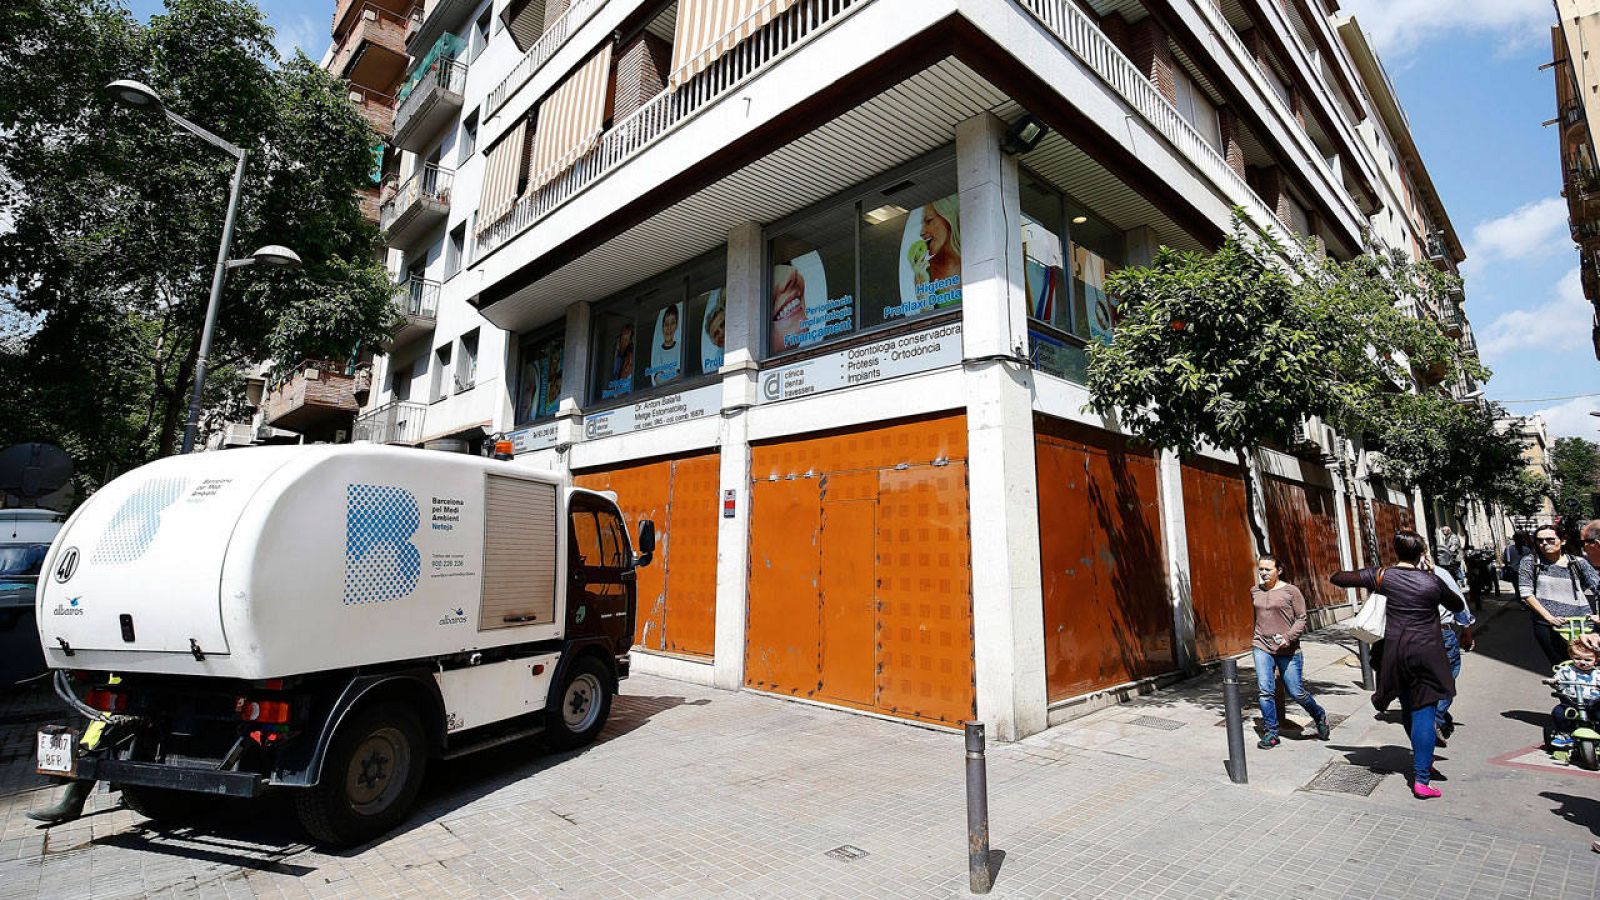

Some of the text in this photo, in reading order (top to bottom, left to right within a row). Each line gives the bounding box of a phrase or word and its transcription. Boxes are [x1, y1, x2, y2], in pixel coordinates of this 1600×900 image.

[915, 275, 960, 295] Higiene
[883, 297, 926, 319] Profilaxi
[784, 320, 853, 347] Finançament
[848, 324, 961, 360] Odontologia conservadora
[785, 379, 805, 388] dental
[848, 369, 881, 383] Implants
[432, 497, 464, 505] Barcelona
[432, 506, 459, 514] pel Medi
[432, 523, 453, 531] Neteja
[57, 551, 77, 579] 40
